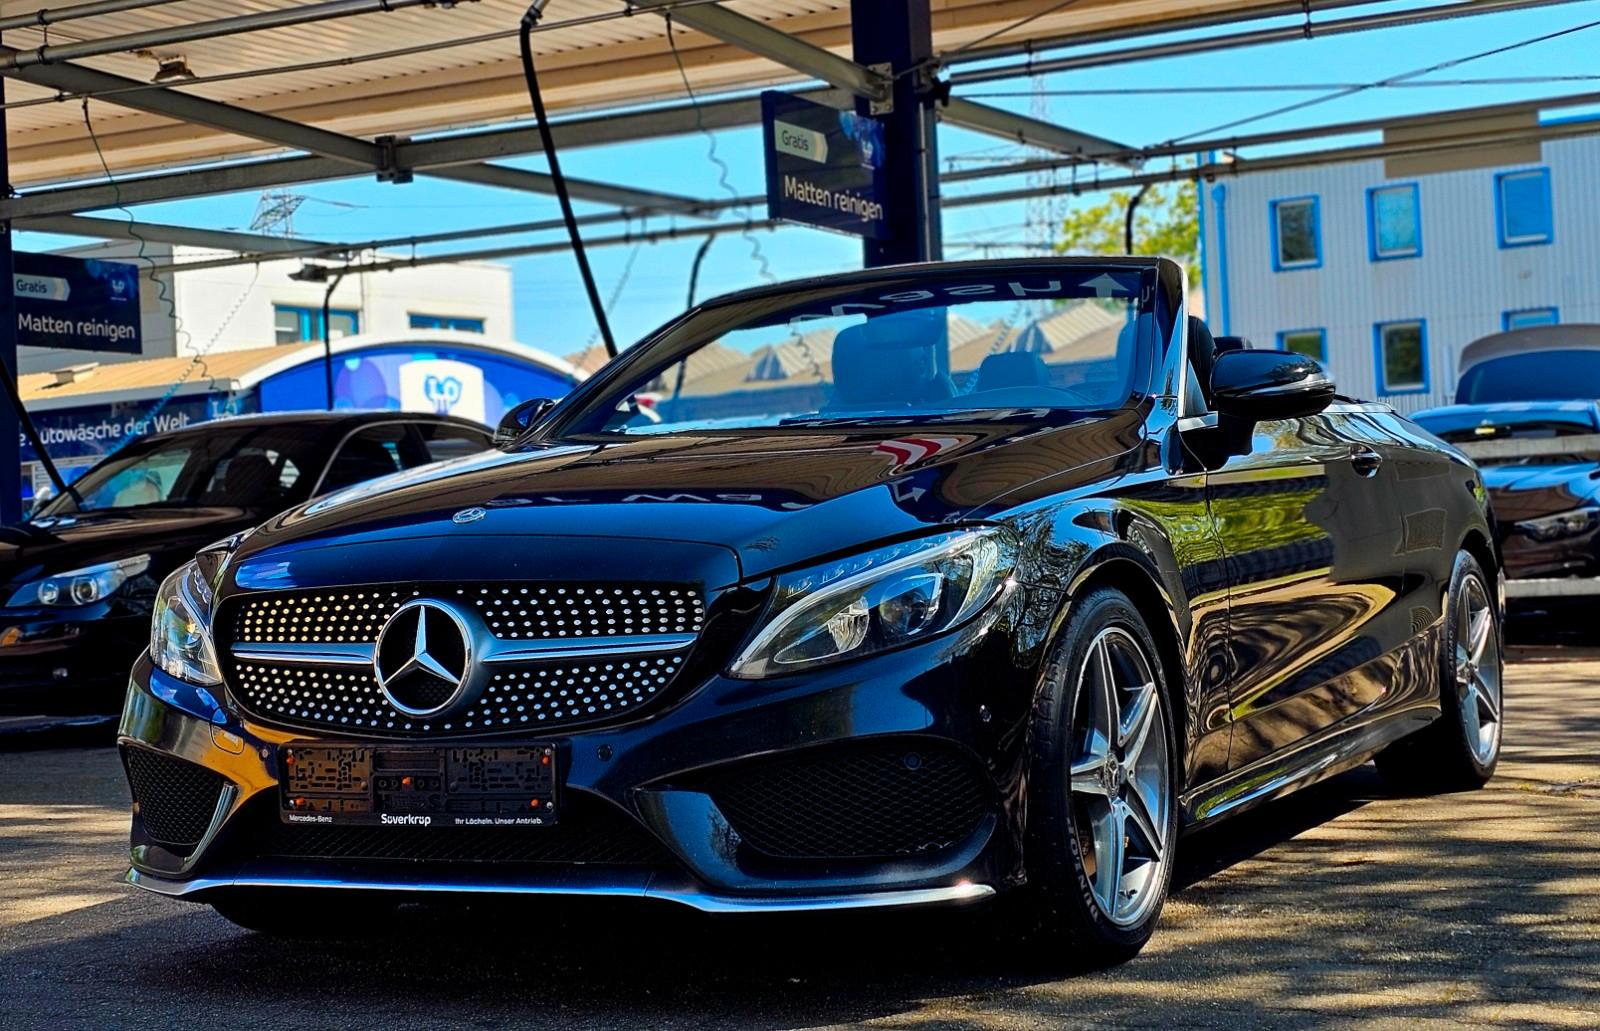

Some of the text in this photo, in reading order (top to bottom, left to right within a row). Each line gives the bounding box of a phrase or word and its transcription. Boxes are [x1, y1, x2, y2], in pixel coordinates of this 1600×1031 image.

[782, 130, 809, 151] Gratis
[784, 175, 884, 222] Matten reinigen
[16, 279, 47, 294] Gratis
[18, 312, 136, 342] Matten reinigen
[28, 420, 121, 446] utowäsche
[124, 417, 150, 436] der
[153, 412, 190, 433] Welt
